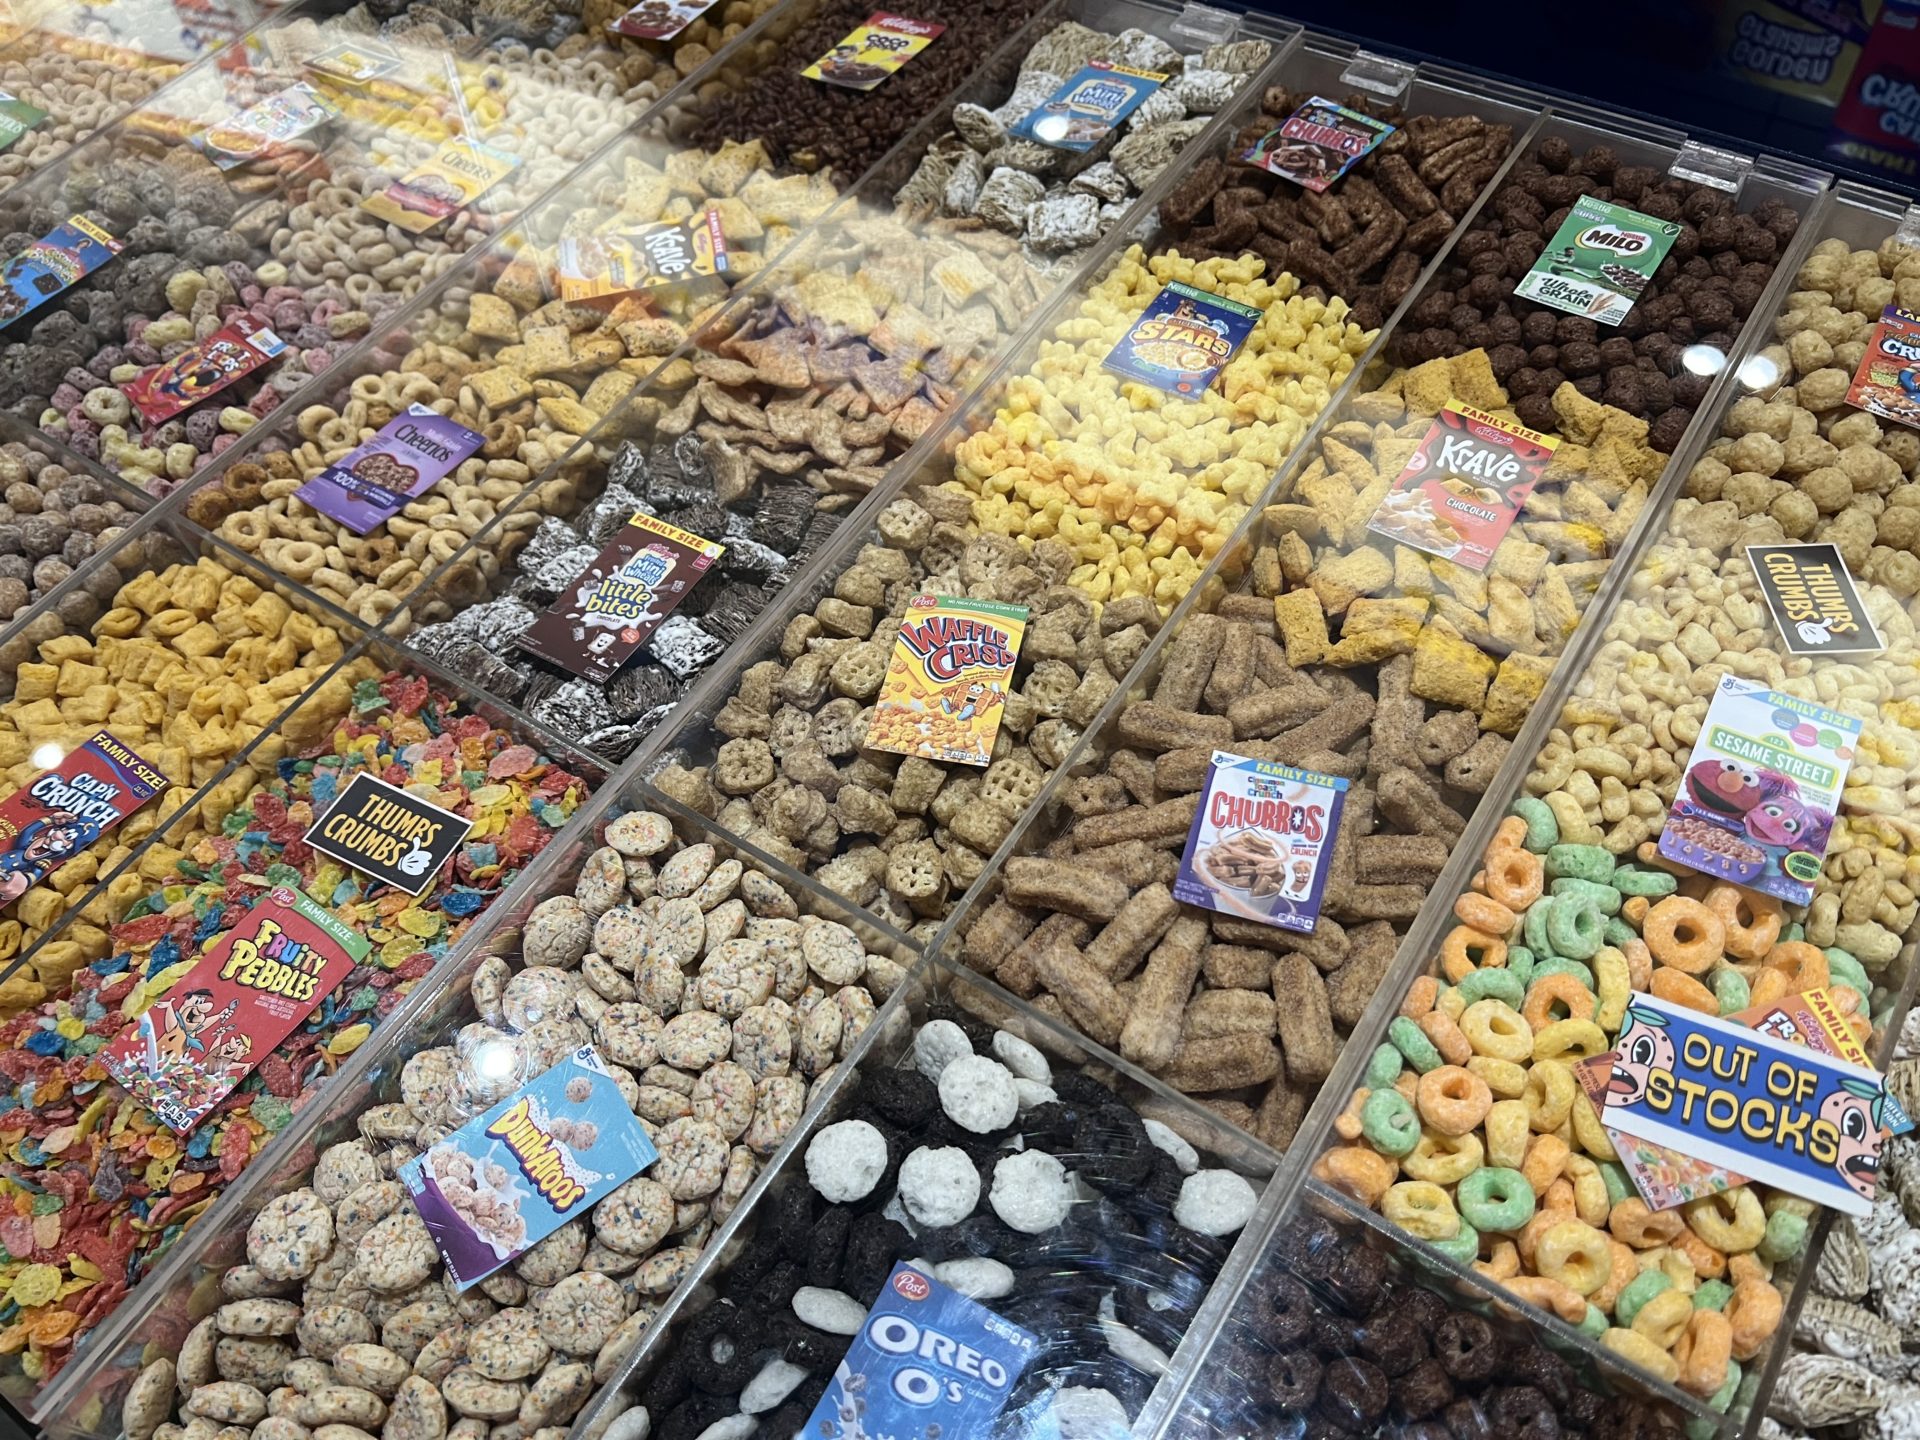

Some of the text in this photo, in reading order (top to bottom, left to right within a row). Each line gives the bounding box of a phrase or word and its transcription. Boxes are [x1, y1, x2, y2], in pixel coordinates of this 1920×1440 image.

[1083, 87, 1125, 102] Mini
[1280, 117, 1371, 157] CHURROS
[708, 211, 720, 238] FAMILY
[1585, 230, 1643, 251] MILO
[1539, 286, 1591, 308] GRAIN
[1541, 277, 1594, 300] Whole
[1133, 321, 1231, 357] STARS
[394, 423, 455, 463] Cheerios
[1461, 406, 1543, 443] FAMILY SIZE
[332, 471, 361, 490] 100%
[1446, 497, 1498, 522] CHOCOLATE
[633, 514, 704, 549] FAMILY SIZE
[624, 567, 658, 586] Wheats
[632, 559, 666, 577] Mini
[599, 579, 652, 605] little
[914, 595, 935, 606] Post
[1764, 553, 1820, 621] CRUMBS
[1801, 563, 1859, 633] THUMBS
[585, 594, 645, 619] bites
[899, 616, 1009, 657] WAFFLE
[927, 643, 1016, 681] CRISP
[1767, 692, 1853, 729] FAMILY SIZE
[92, 733, 168, 791] FAMILY SIZE!
[1256, 763, 1335, 788] FAMILY SIZE
[1714, 731, 1832, 786] SESAME STREET
[31, 776, 121, 828] CRUNCH
[71, 773, 121, 801] CAP'N
[357, 793, 443, 848] THUMBS
[1210, 791, 1325, 842] CHURROS
[323, 813, 408, 867] CRUMBS
[274, 886, 351, 941] Post FAMILY SIZE
[219, 938, 320, 1002] PEBBLES
[1809, 991, 1852, 1042] FAMILY
[1683, 1032, 1819, 1103] OUT OF
[1644, 1067, 1841, 1166] STOCKS
[900, 1274, 926, 1295] Post
[870, 1315, 1008, 1388] OREO
